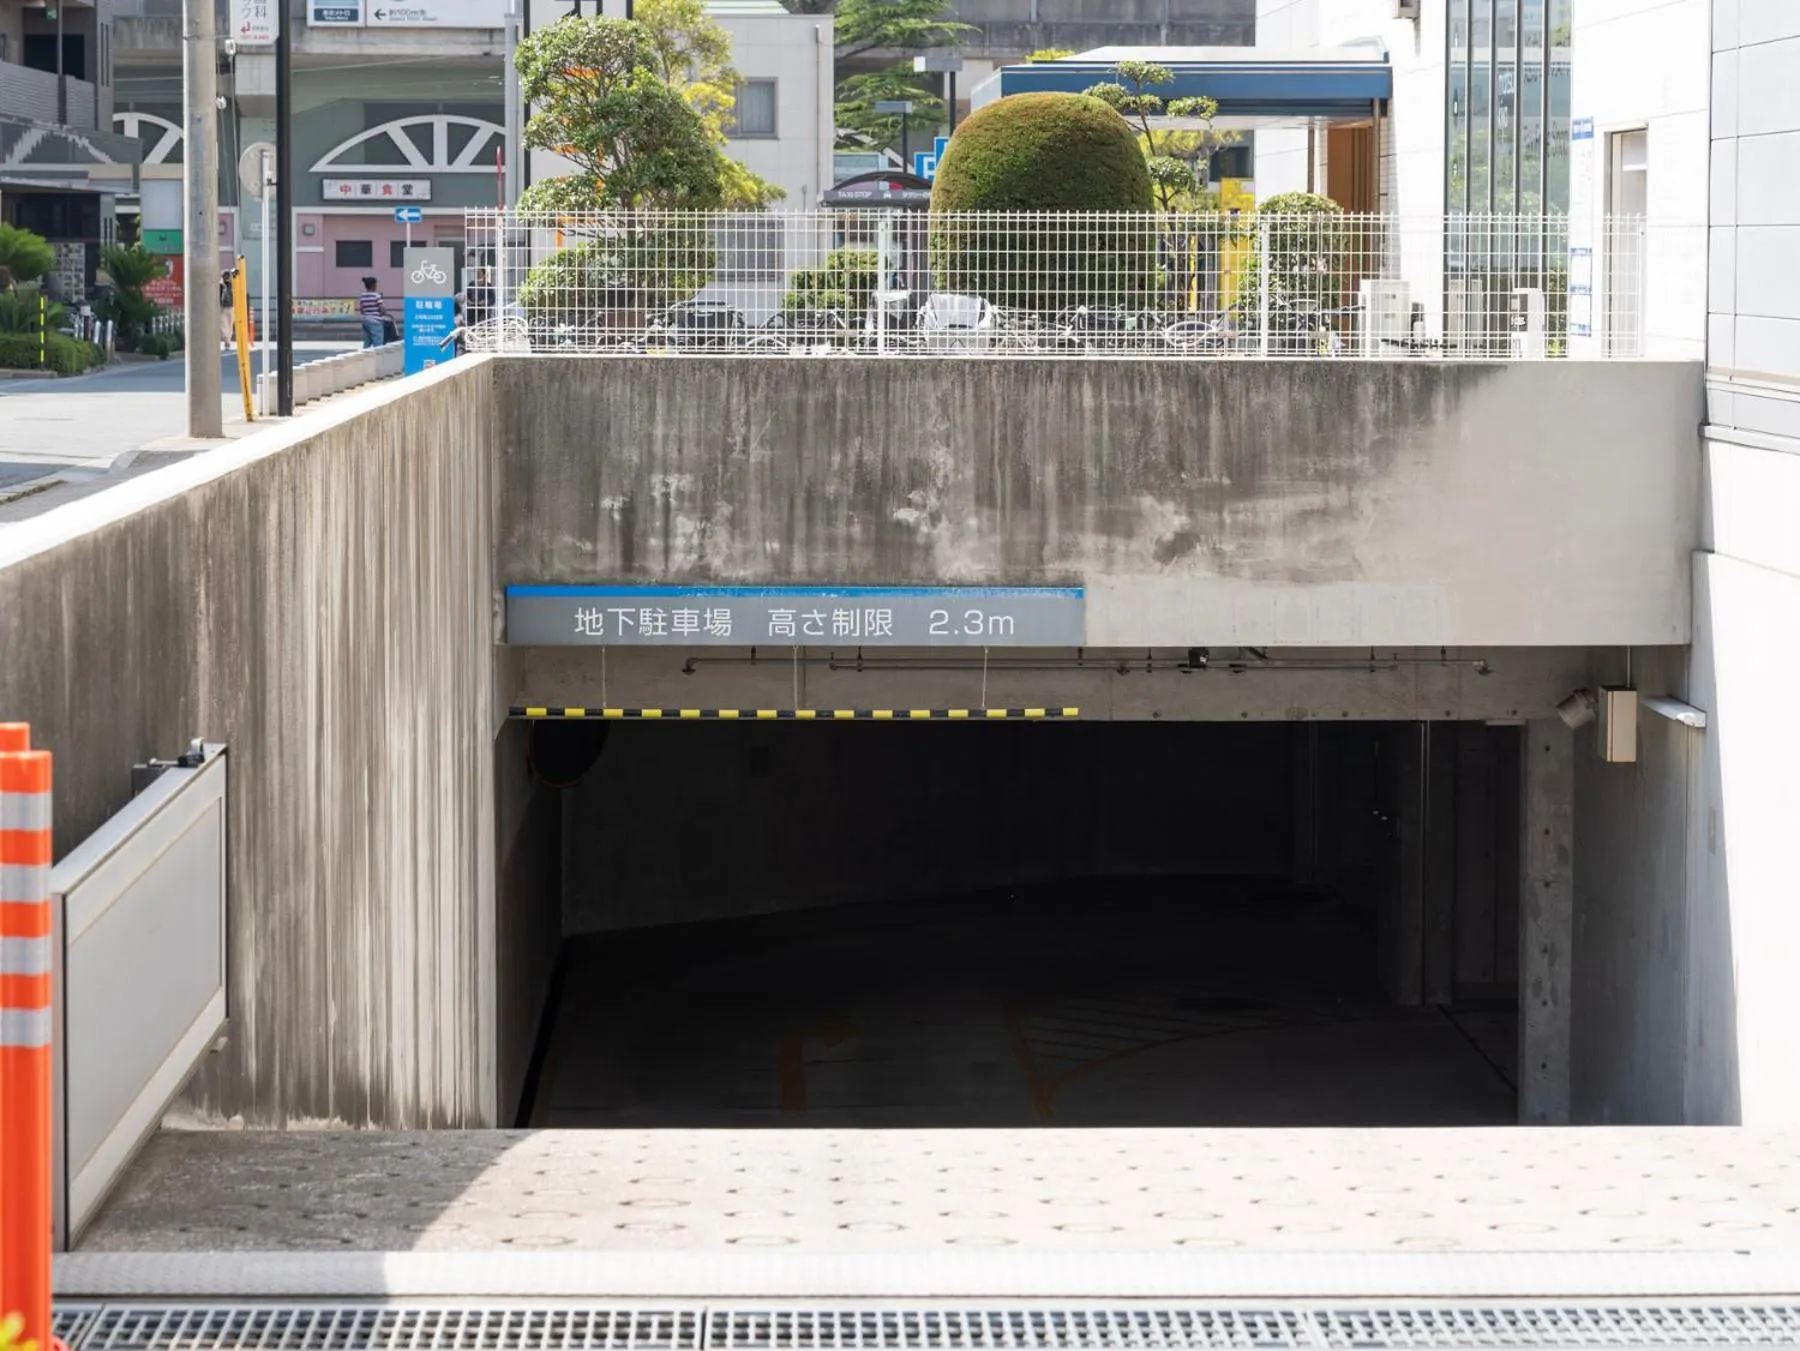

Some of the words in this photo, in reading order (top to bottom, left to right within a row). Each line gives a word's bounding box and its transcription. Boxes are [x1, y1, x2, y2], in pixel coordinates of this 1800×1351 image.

[340, 183, 414, 196] 中華食堂
[838, 191, 853, 199] TAXI
[854, 191, 873, 199] STOP
[574, 607, 733, 637] 地下駐車場
[767, 607, 894, 637] 高さ制限
[928, 609, 1015, 636] 2.3m
